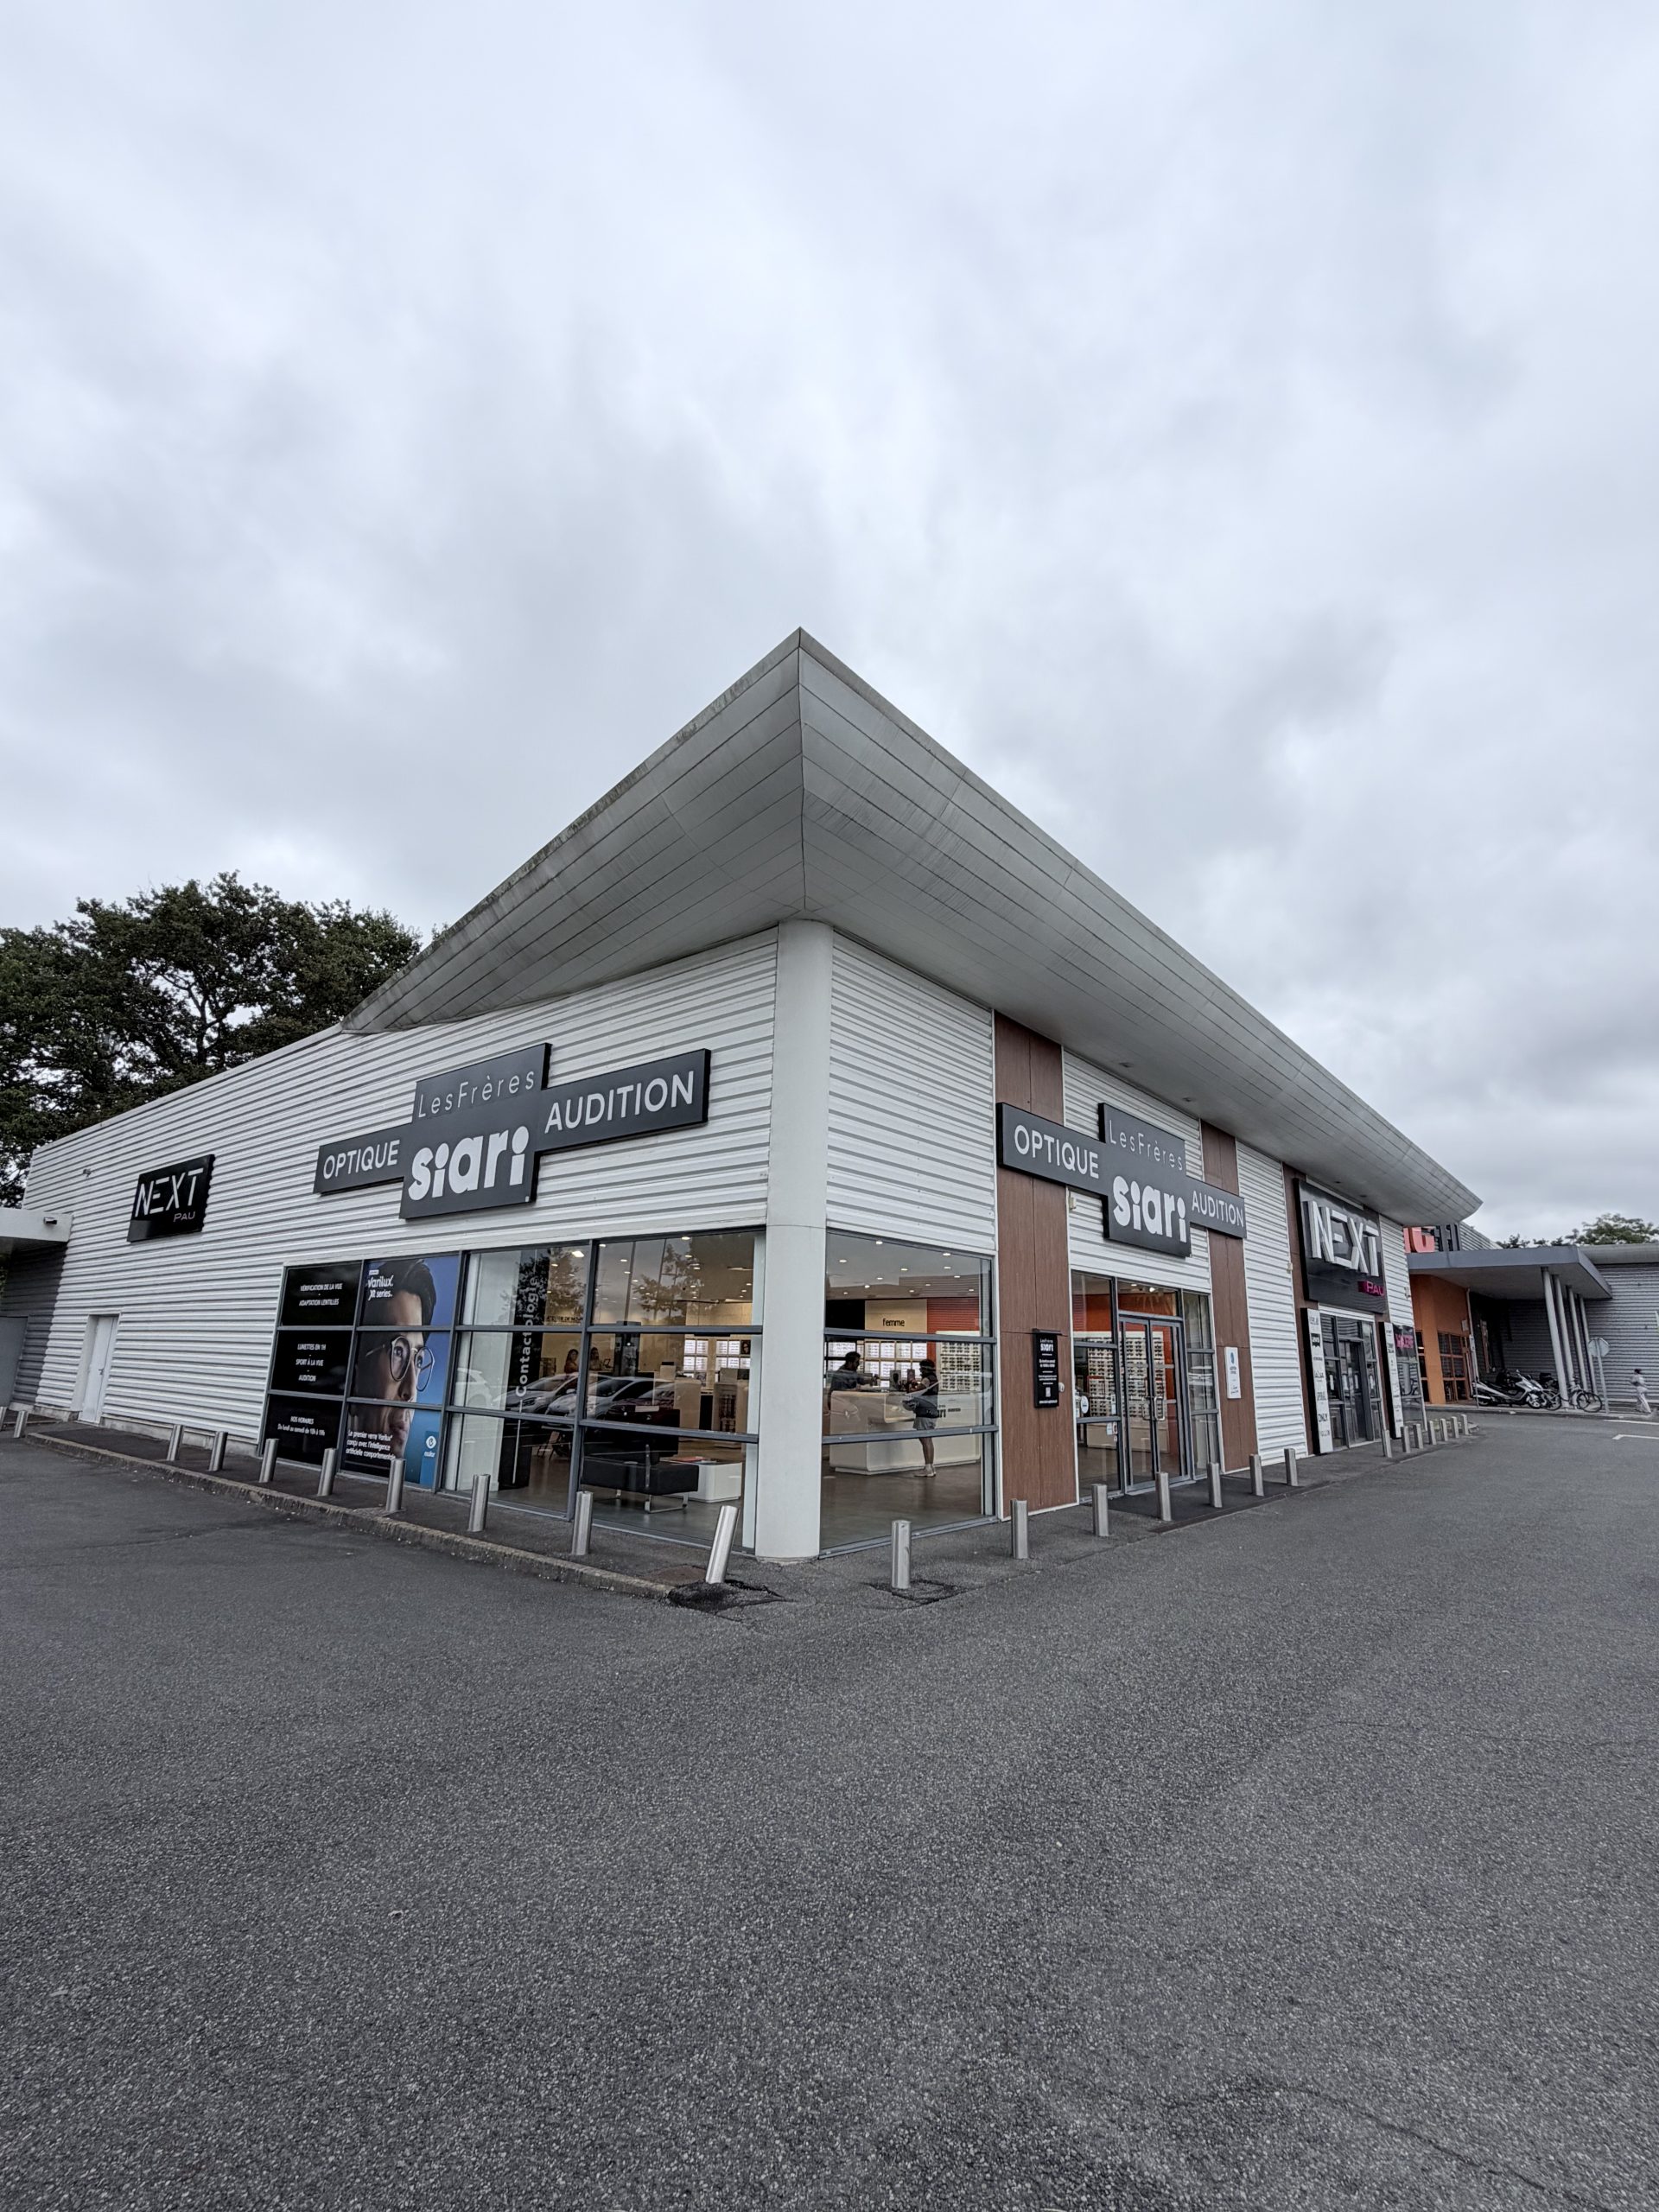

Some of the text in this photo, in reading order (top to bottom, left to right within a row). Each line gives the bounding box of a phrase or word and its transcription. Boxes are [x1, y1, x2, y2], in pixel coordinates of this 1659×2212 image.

[544, 1071, 694, 1134] AUDITION
[323, 1140, 400, 1179] OPTIQUE
[408, 1126, 530, 1201] siari
[1014, 1124, 1099, 1179] OPTIQUE
[135, 1167, 204, 1217] NEXT
[173, 1211, 196, 1223] PAU
[1112, 1175, 1187, 1243] siari
[1192, 1191, 1244, 1228] AUDITION
[1307, 1200, 1380, 1277] NEXT
[1365, 1281, 1385, 1296] PAU
[882, 1318, 905, 1326] femme
